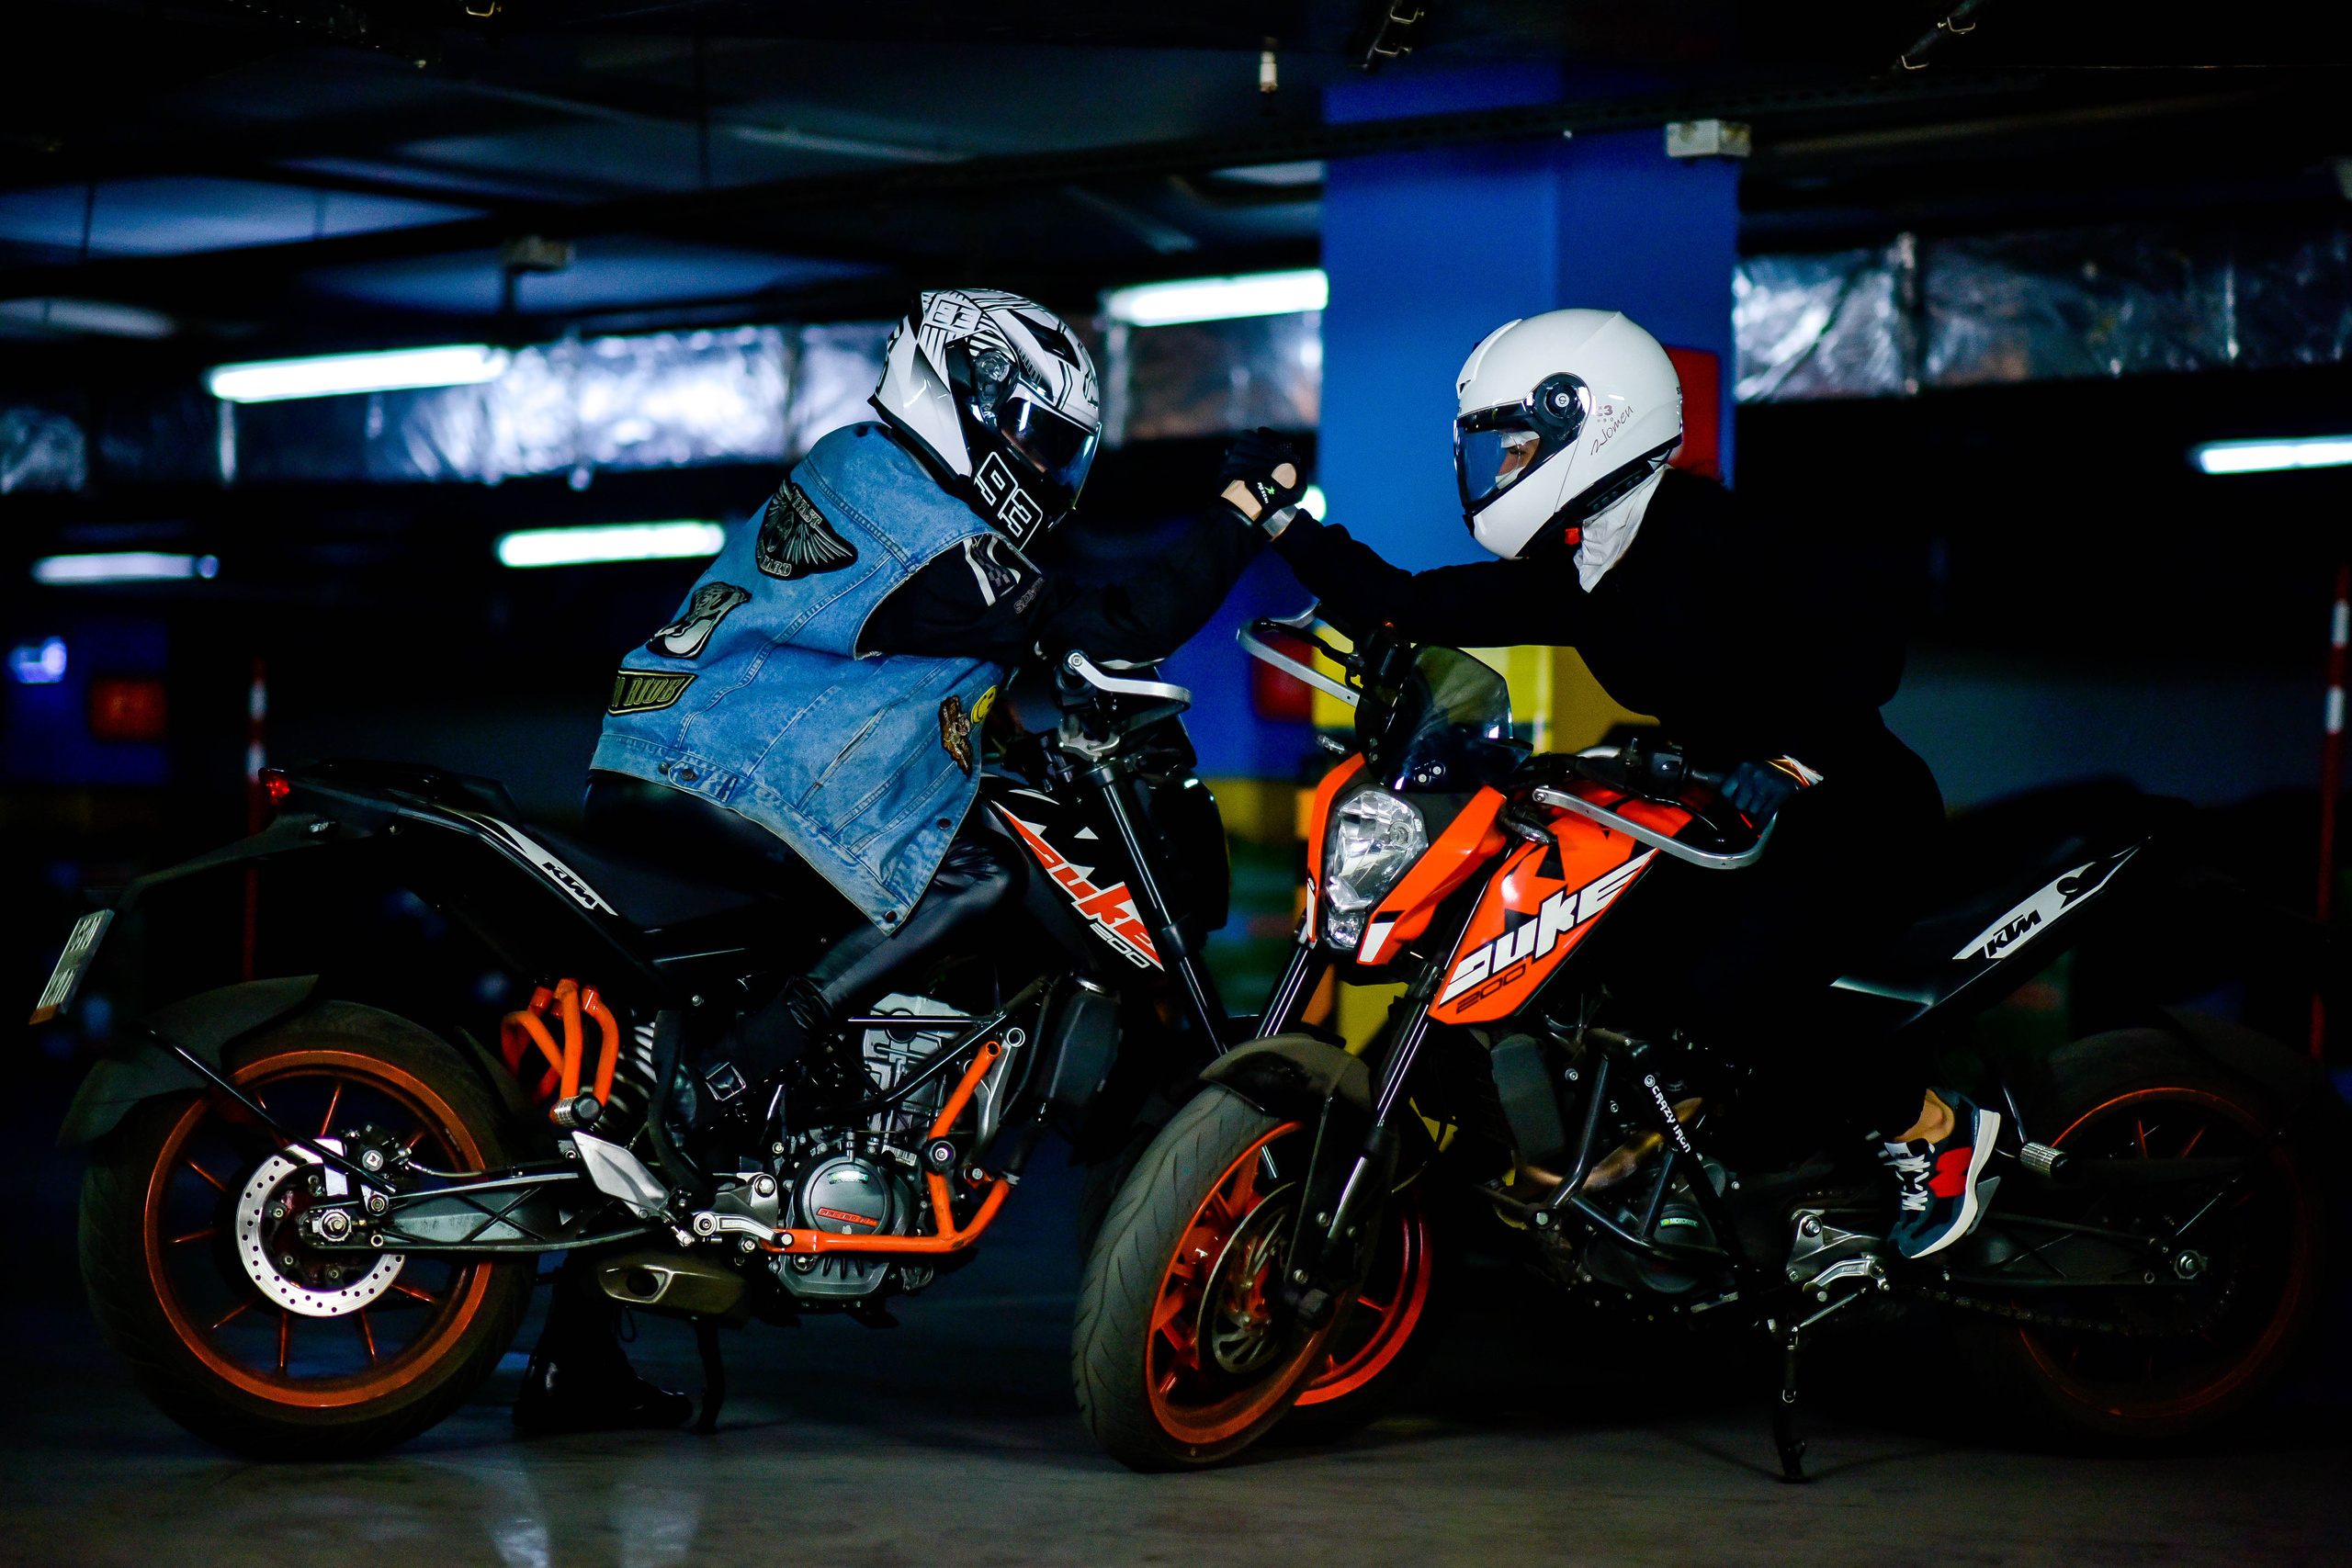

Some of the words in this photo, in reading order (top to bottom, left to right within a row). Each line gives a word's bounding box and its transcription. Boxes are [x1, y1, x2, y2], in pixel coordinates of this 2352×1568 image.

[542, 862, 595, 907] KTM
[1089, 922, 1150, 968] 200
[1986, 909, 2042, 957] KTM
[1456, 964, 1526, 1014] 200
